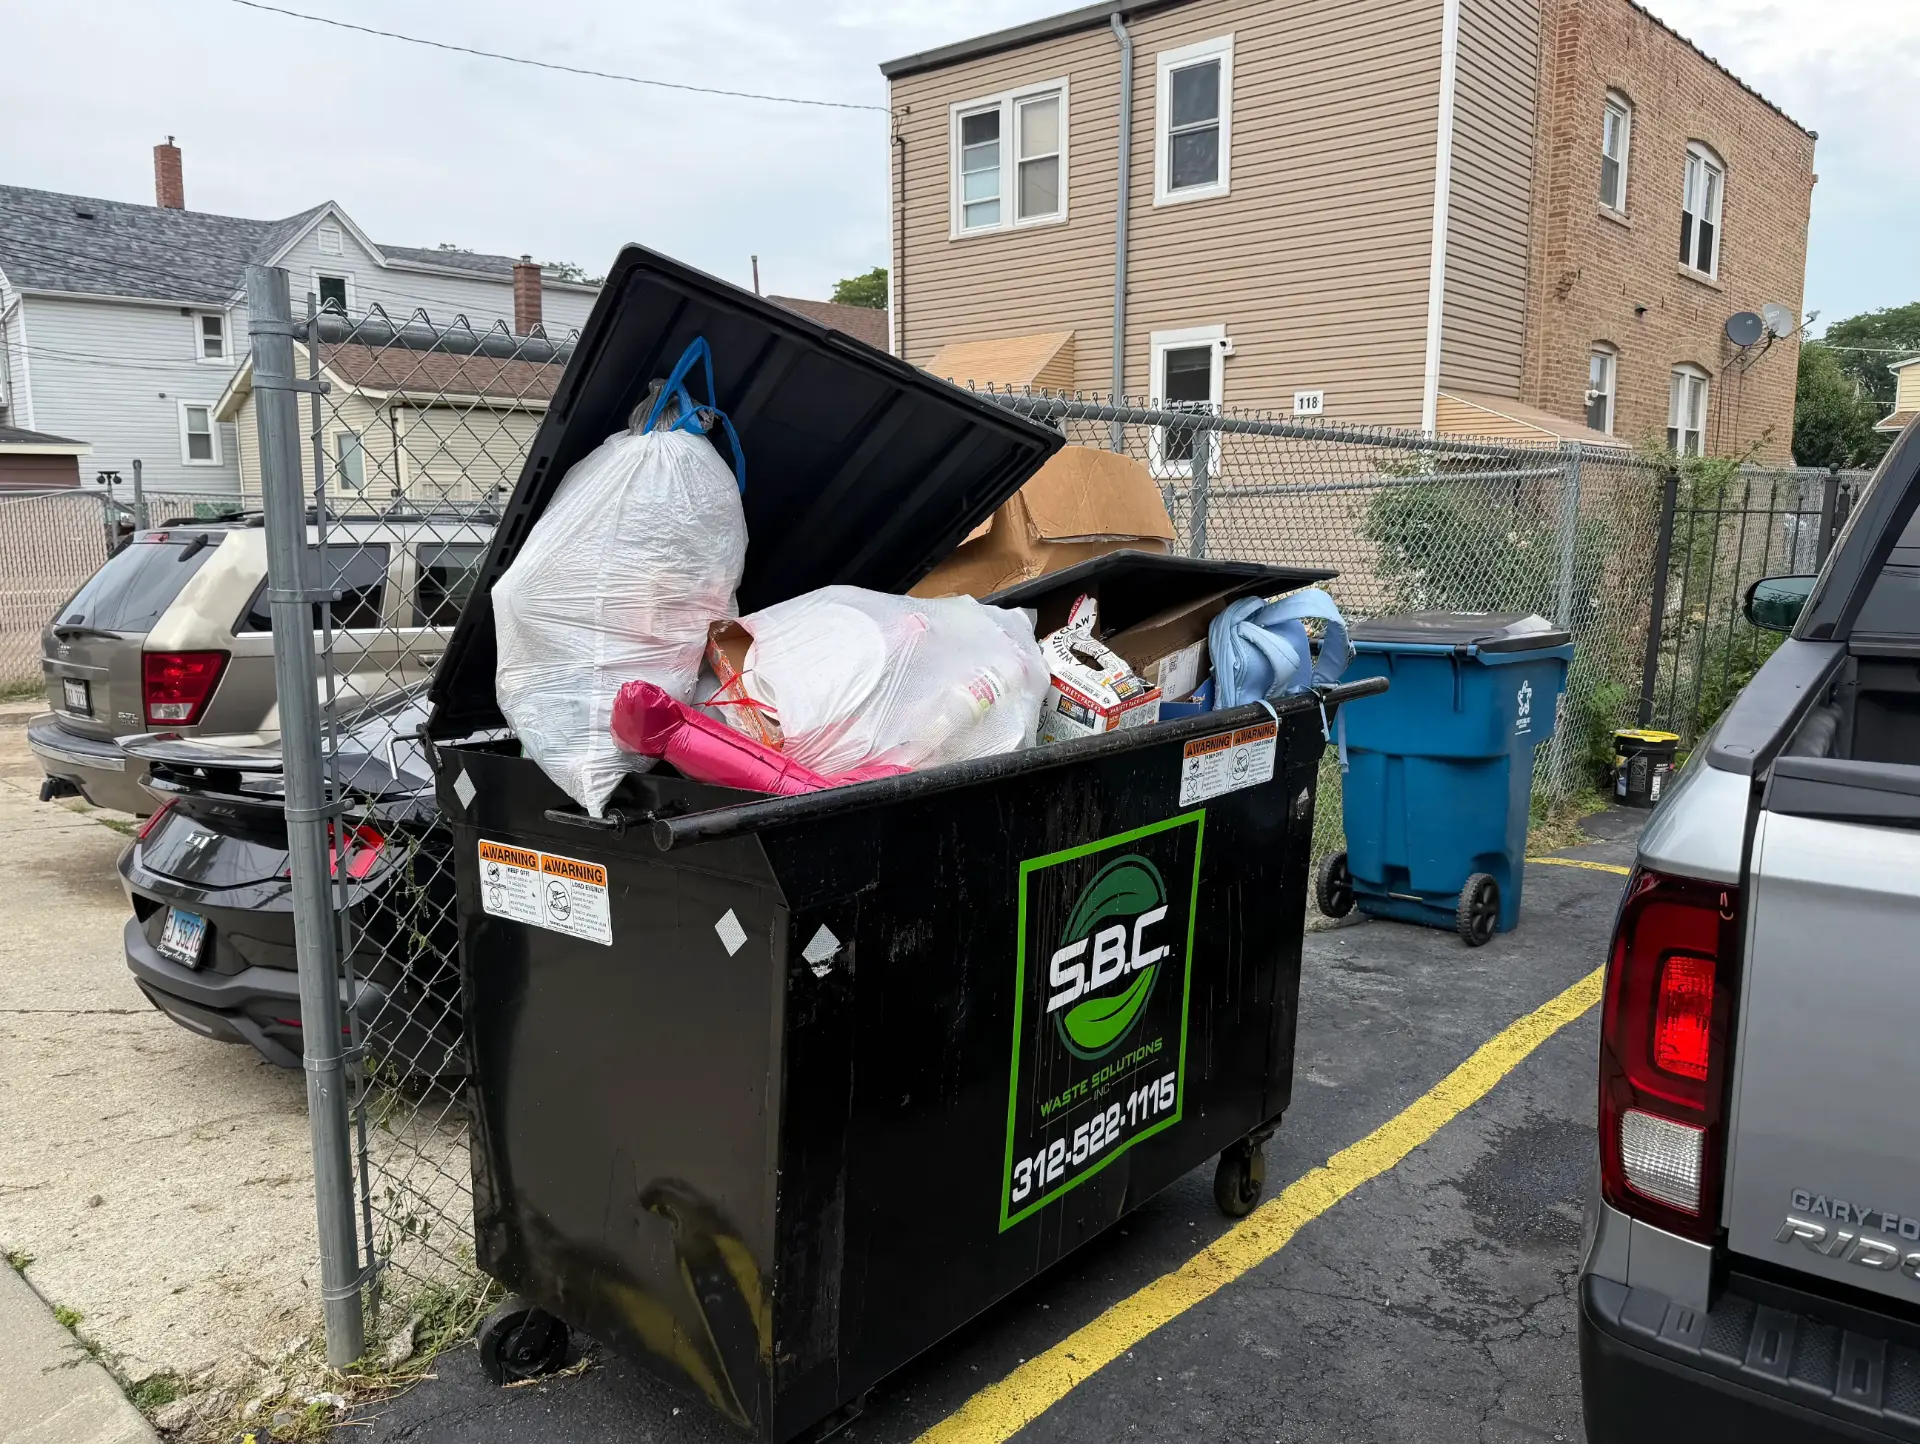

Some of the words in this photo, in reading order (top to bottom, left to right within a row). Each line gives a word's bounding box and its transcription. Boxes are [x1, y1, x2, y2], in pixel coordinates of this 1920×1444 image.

[1299, 396, 1318, 410] 118
[1060, 614, 1090, 635] CLAW
[1053, 635, 1073, 664] WHITE
[1060, 683, 1080, 699] VARIETY
[1080, 696, 1095, 709] PACK
[1109, 702, 1128, 714] VARIETY
[1242, 725, 1275, 742] WARNING
[1194, 736, 1230, 754] WARNING
[488, 846, 536, 868] WARNING
[551, 859, 603, 883] WARNING
[572, 881, 585, 890] LOAD
[1046, 904, 1170, 1014] S.B.C.
[1040, 1079, 1089, 1118] WASTE
[1091, 1037, 1163, 1089] SOLUTIONS
[1093, 1082, 1111, 1101] INC
[1012, 1071, 1176, 1204] 312-522-1115
[1790, 1187, 1874, 1226] GARY
[1880, 1212, 1920, 1240] FO
